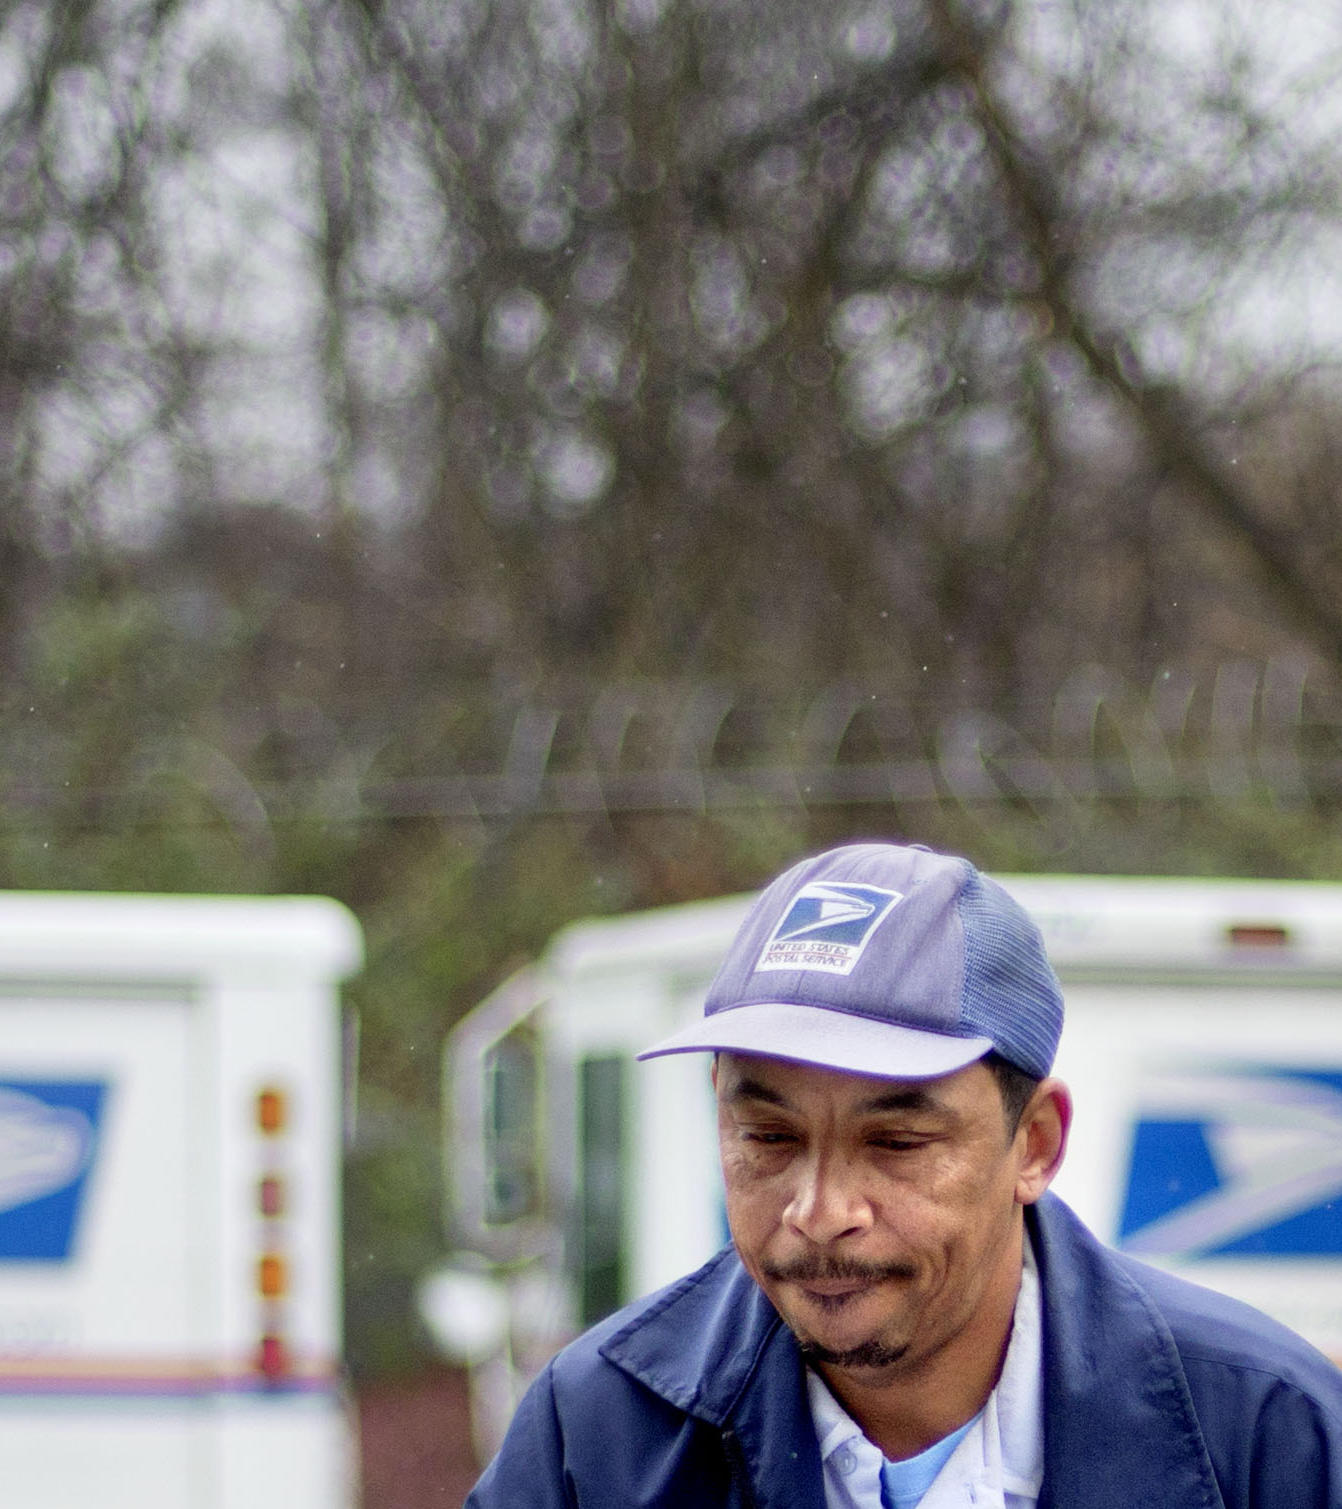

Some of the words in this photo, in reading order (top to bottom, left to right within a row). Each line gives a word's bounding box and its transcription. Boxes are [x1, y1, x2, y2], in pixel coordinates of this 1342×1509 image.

[769, 942, 806, 952] UNITED
[810, 943, 850, 955] STATES
[762, 953, 799, 964] POSTAL
[803, 954, 846, 966] SERVICE
